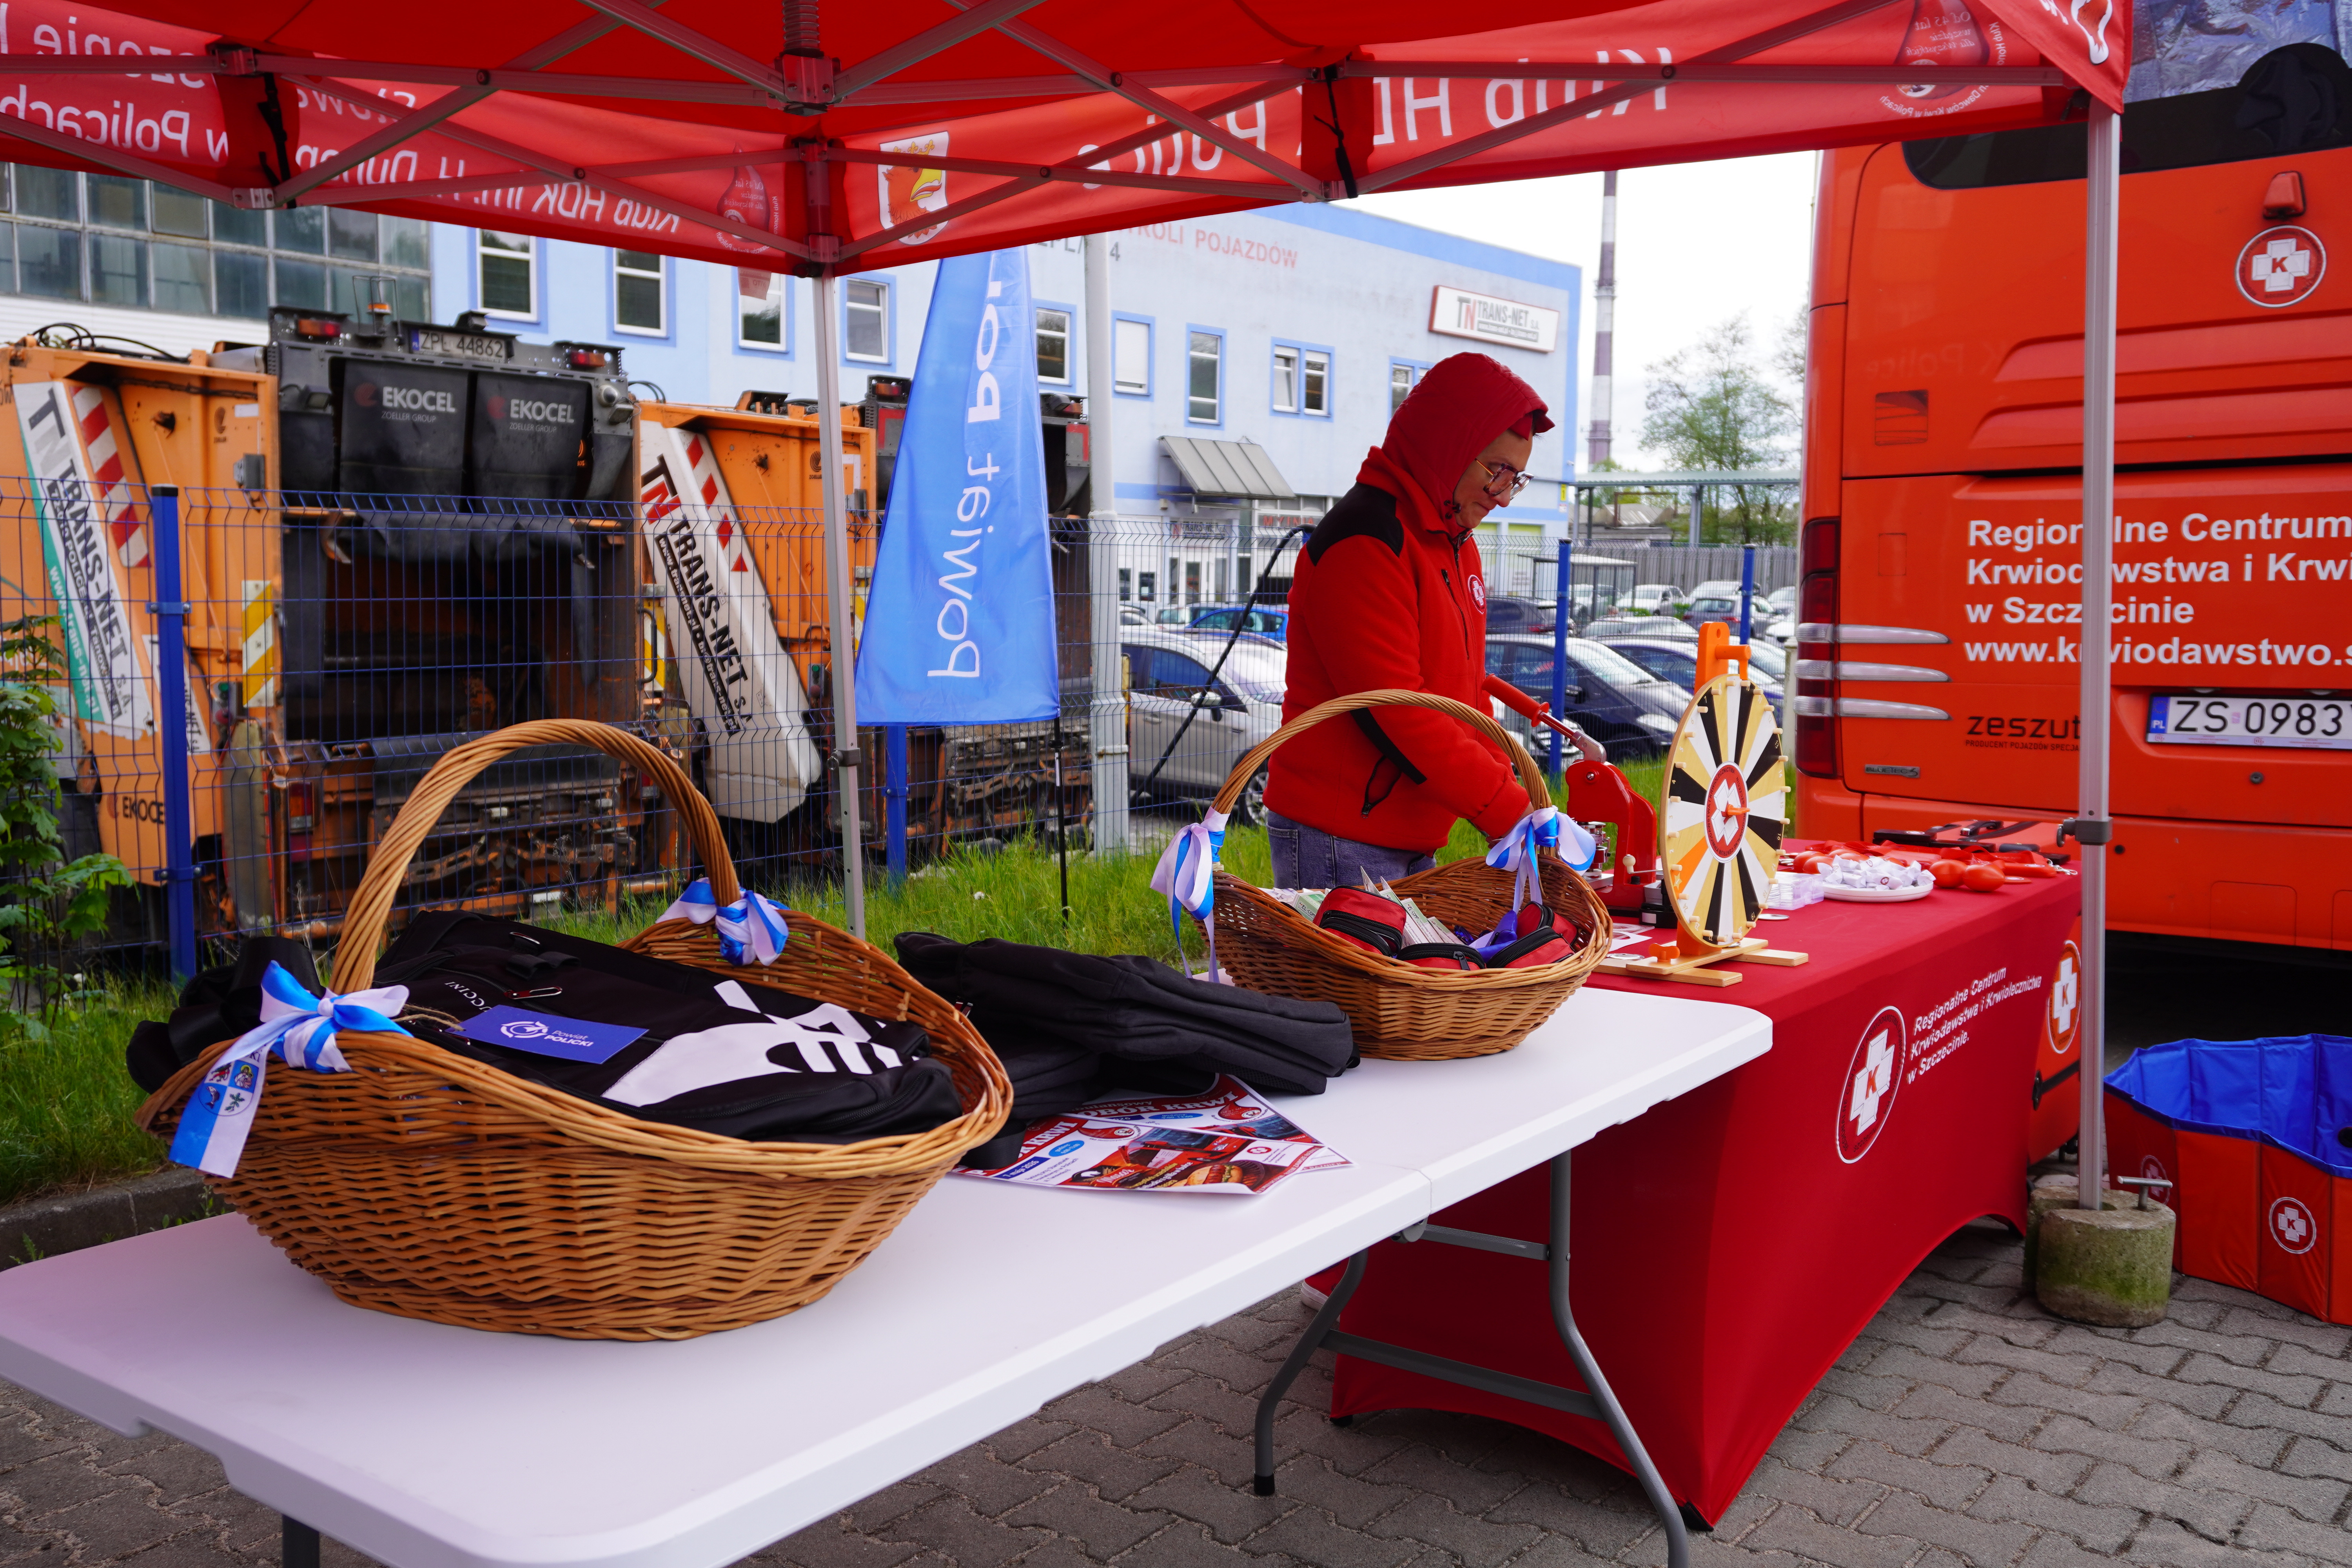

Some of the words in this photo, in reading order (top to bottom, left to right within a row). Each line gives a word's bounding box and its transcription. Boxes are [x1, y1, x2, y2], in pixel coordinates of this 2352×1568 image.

[1195, 229, 1298, 269] POJAZDÓW
[2271, 256, 2289, 273] K
[1477, 299, 1530, 328] TRANS-NET
[421, 332, 450, 352] ZPL
[456, 336, 503, 358] 44862
[382, 386, 456, 413] EKOCEL
[510, 398, 575, 423] EKOCEL
[381, 411, 410, 421] ZOELLER
[412, 414, 437, 423] GROUP
[509, 422, 534, 432] ZOELLER
[535, 425, 557, 433] GROUP
[1968, 515, 2168, 552] Regionlne
[2181, 512, 2352, 542] Centrum
[59, 458, 128, 663] TRANS-NET
[2243, 554, 2253, 582] i
[668, 514, 748, 686] TRANS-NET
[1965, 603, 1993, 623] w
[2002, 595, 2195, 624] Szczcinie
[2152, 720, 2165, 729] PL
[2174, 700, 2229, 733] ZS
[2245, 701, 2352, 736] 0983
[1775, 739, 1779, 749] 13
[1965, 739, 2008, 749] PRODUCENT
[2010, 740, 2048, 750] POJAZDÓW
[2051, 743, 2080, 751] SPECJA
[122, 796, 165, 825] EKOCE
[1777, 833, 1782, 841] 16
[1301, 904, 1316, 917] EL-COM
[1407, 906, 1419, 919] EL-COMP
[1751, 911, 1756, 920] 19
[444, 981, 493, 1012] UCCINI
[1914, 987, 1969, 1036] Regionalne
[1970, 966, 2007, 997] Centrum
[2062, 982, 2069, 1007] K
[1910, 1004, 1979, 1061] Krwiodawstwa
[1985, 973, 2042, 1009] Krwiolecznictwa
[543, 1034, 595, 1047] POLICKI
[552, 1030, 588, 1041] Powiat
[1865, 1063, 1880, 1100] K
[1907, 1064, 1917, 1085] w
[1077, 1105, 1160, 1118] OBÓR
[1162, 1091, 1239, 1110] KRWI
[1031, 1120, 1078, 1146] KRWI
[2287, 1218, 2296, 1230] K
